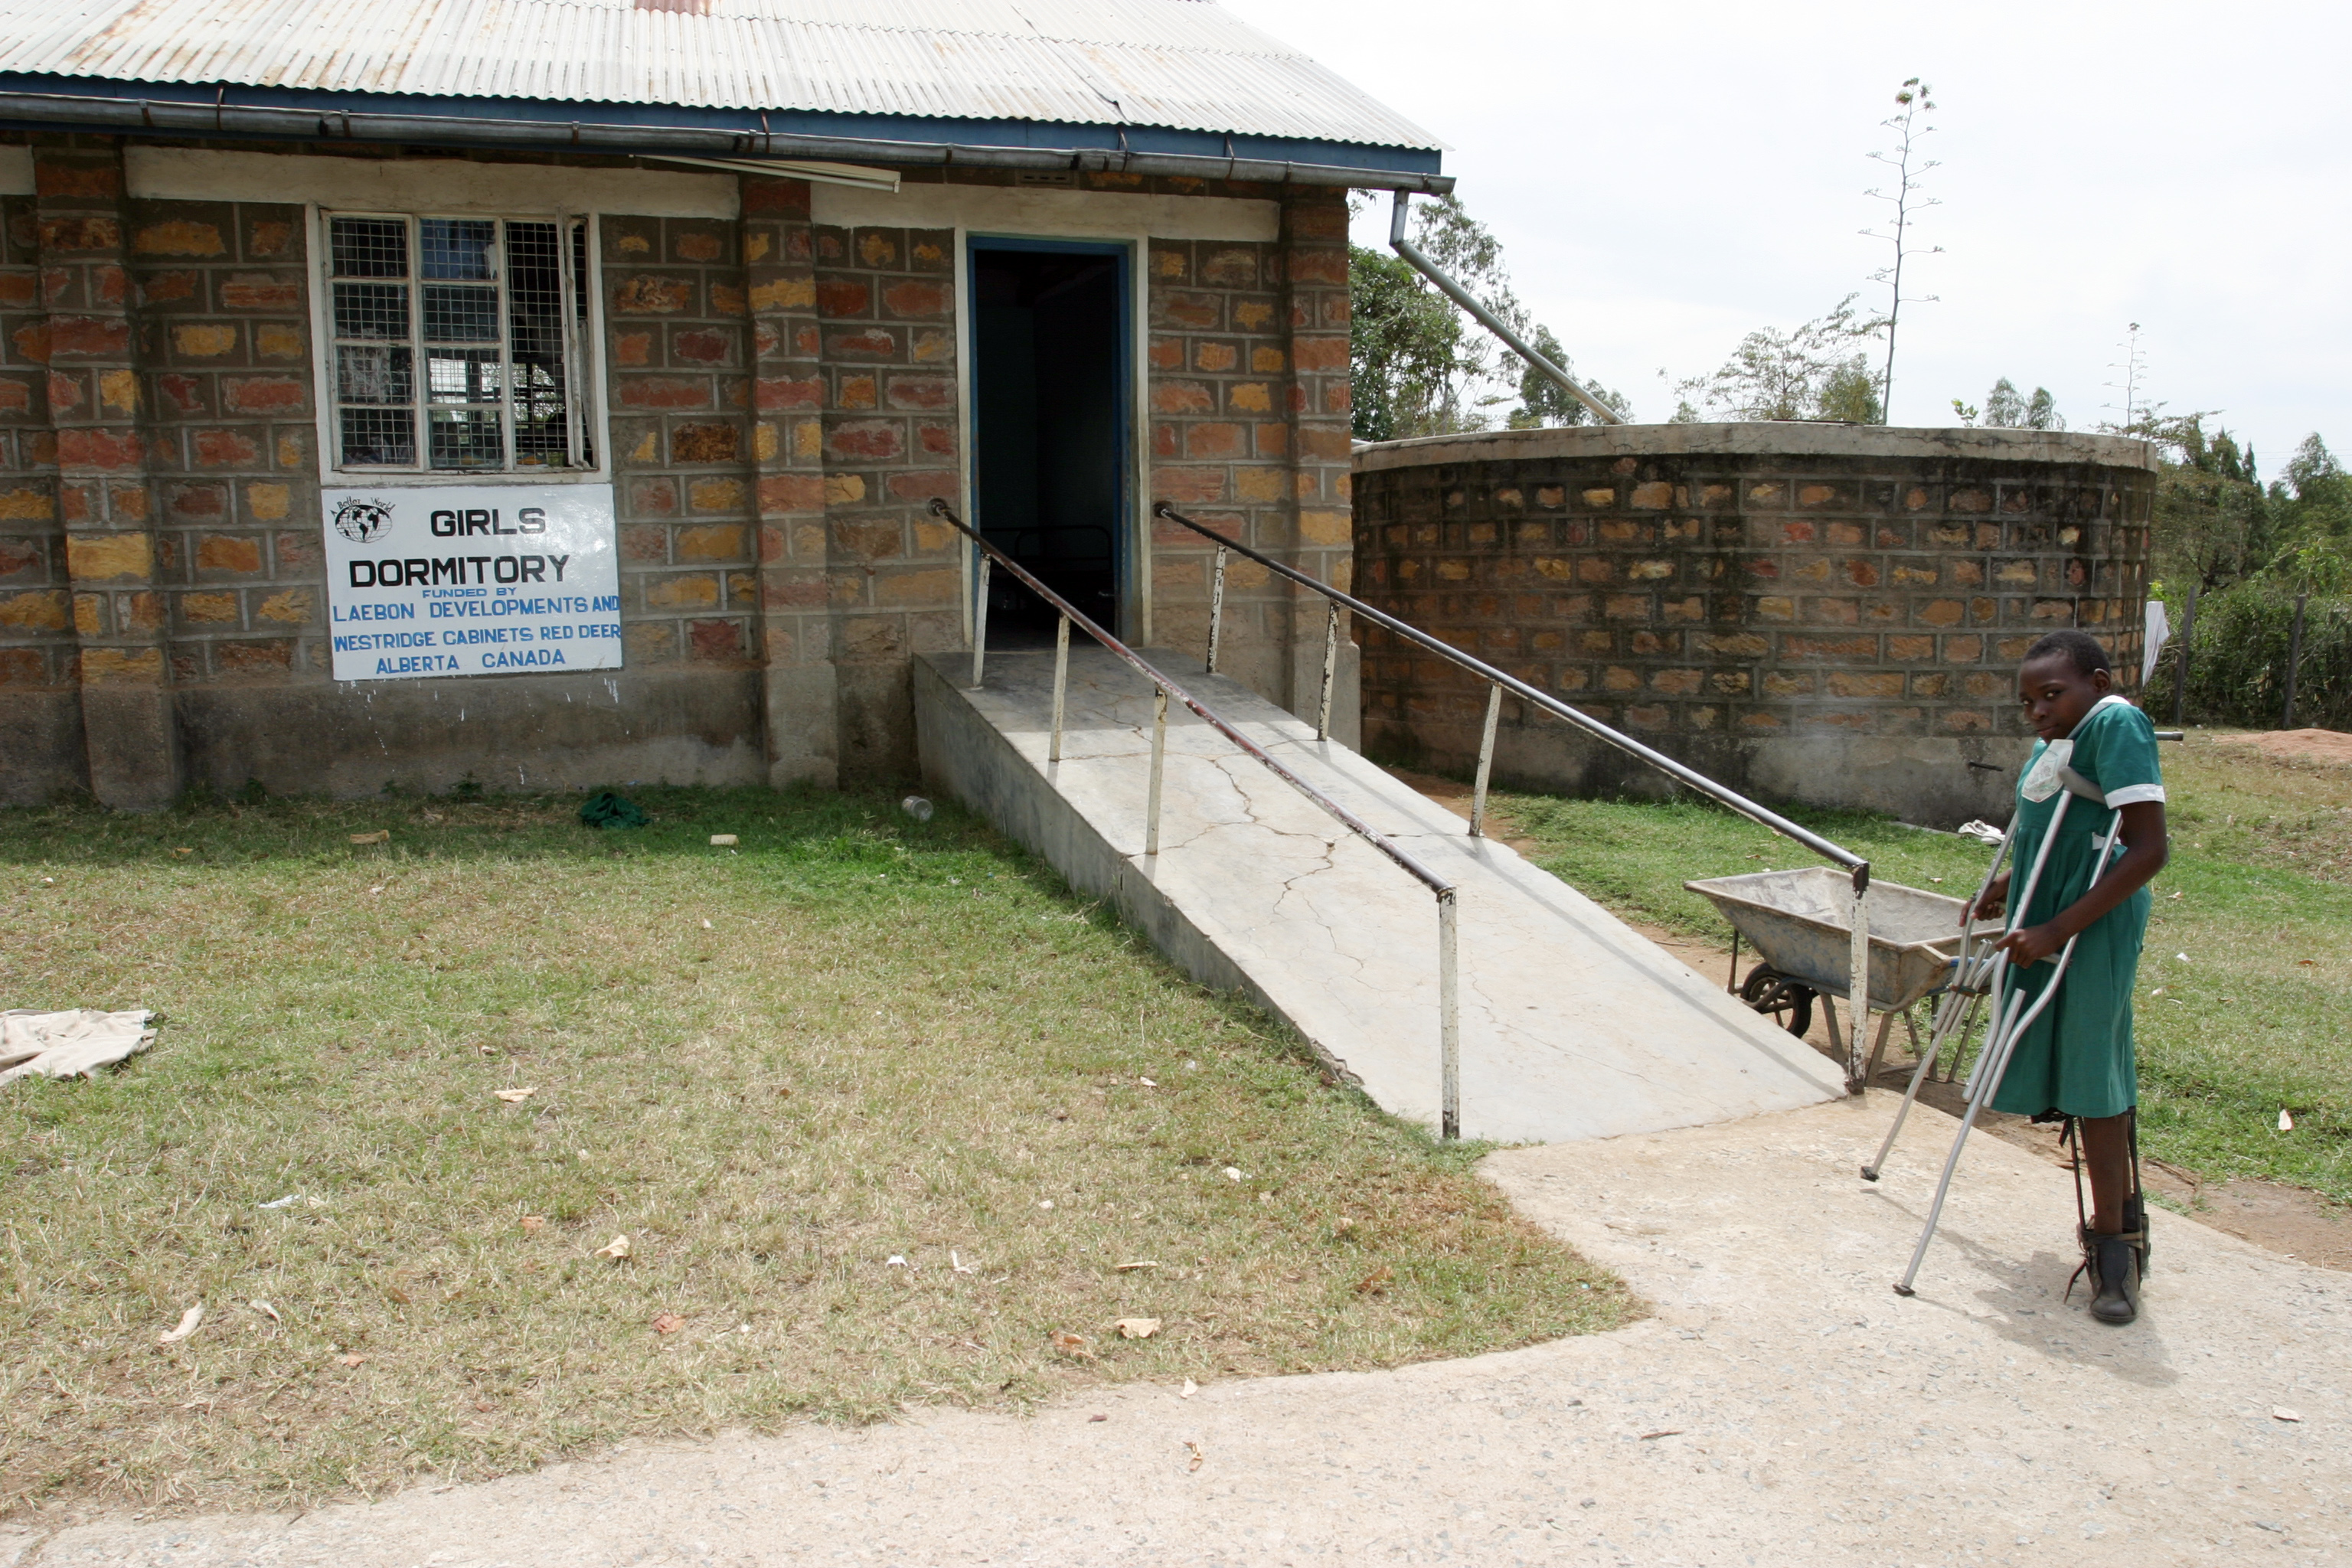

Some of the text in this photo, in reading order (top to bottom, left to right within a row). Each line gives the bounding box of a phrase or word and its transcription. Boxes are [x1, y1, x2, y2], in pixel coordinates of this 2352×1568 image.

[371, 497, 397, 514] World
[430, 508, 546, 537] GIRLS
[349, 554, 570, 587] DORMITORY
[422, 587, 517, 599] FUNDED BY
[333, 595, 619, 622] LAEBON DEVELOPMENTS AND
[334, 623, 621, 652] WESTRIDGE CABINETS RED DEER
[376, 648, 566, 675] ALBERTA CANADA
